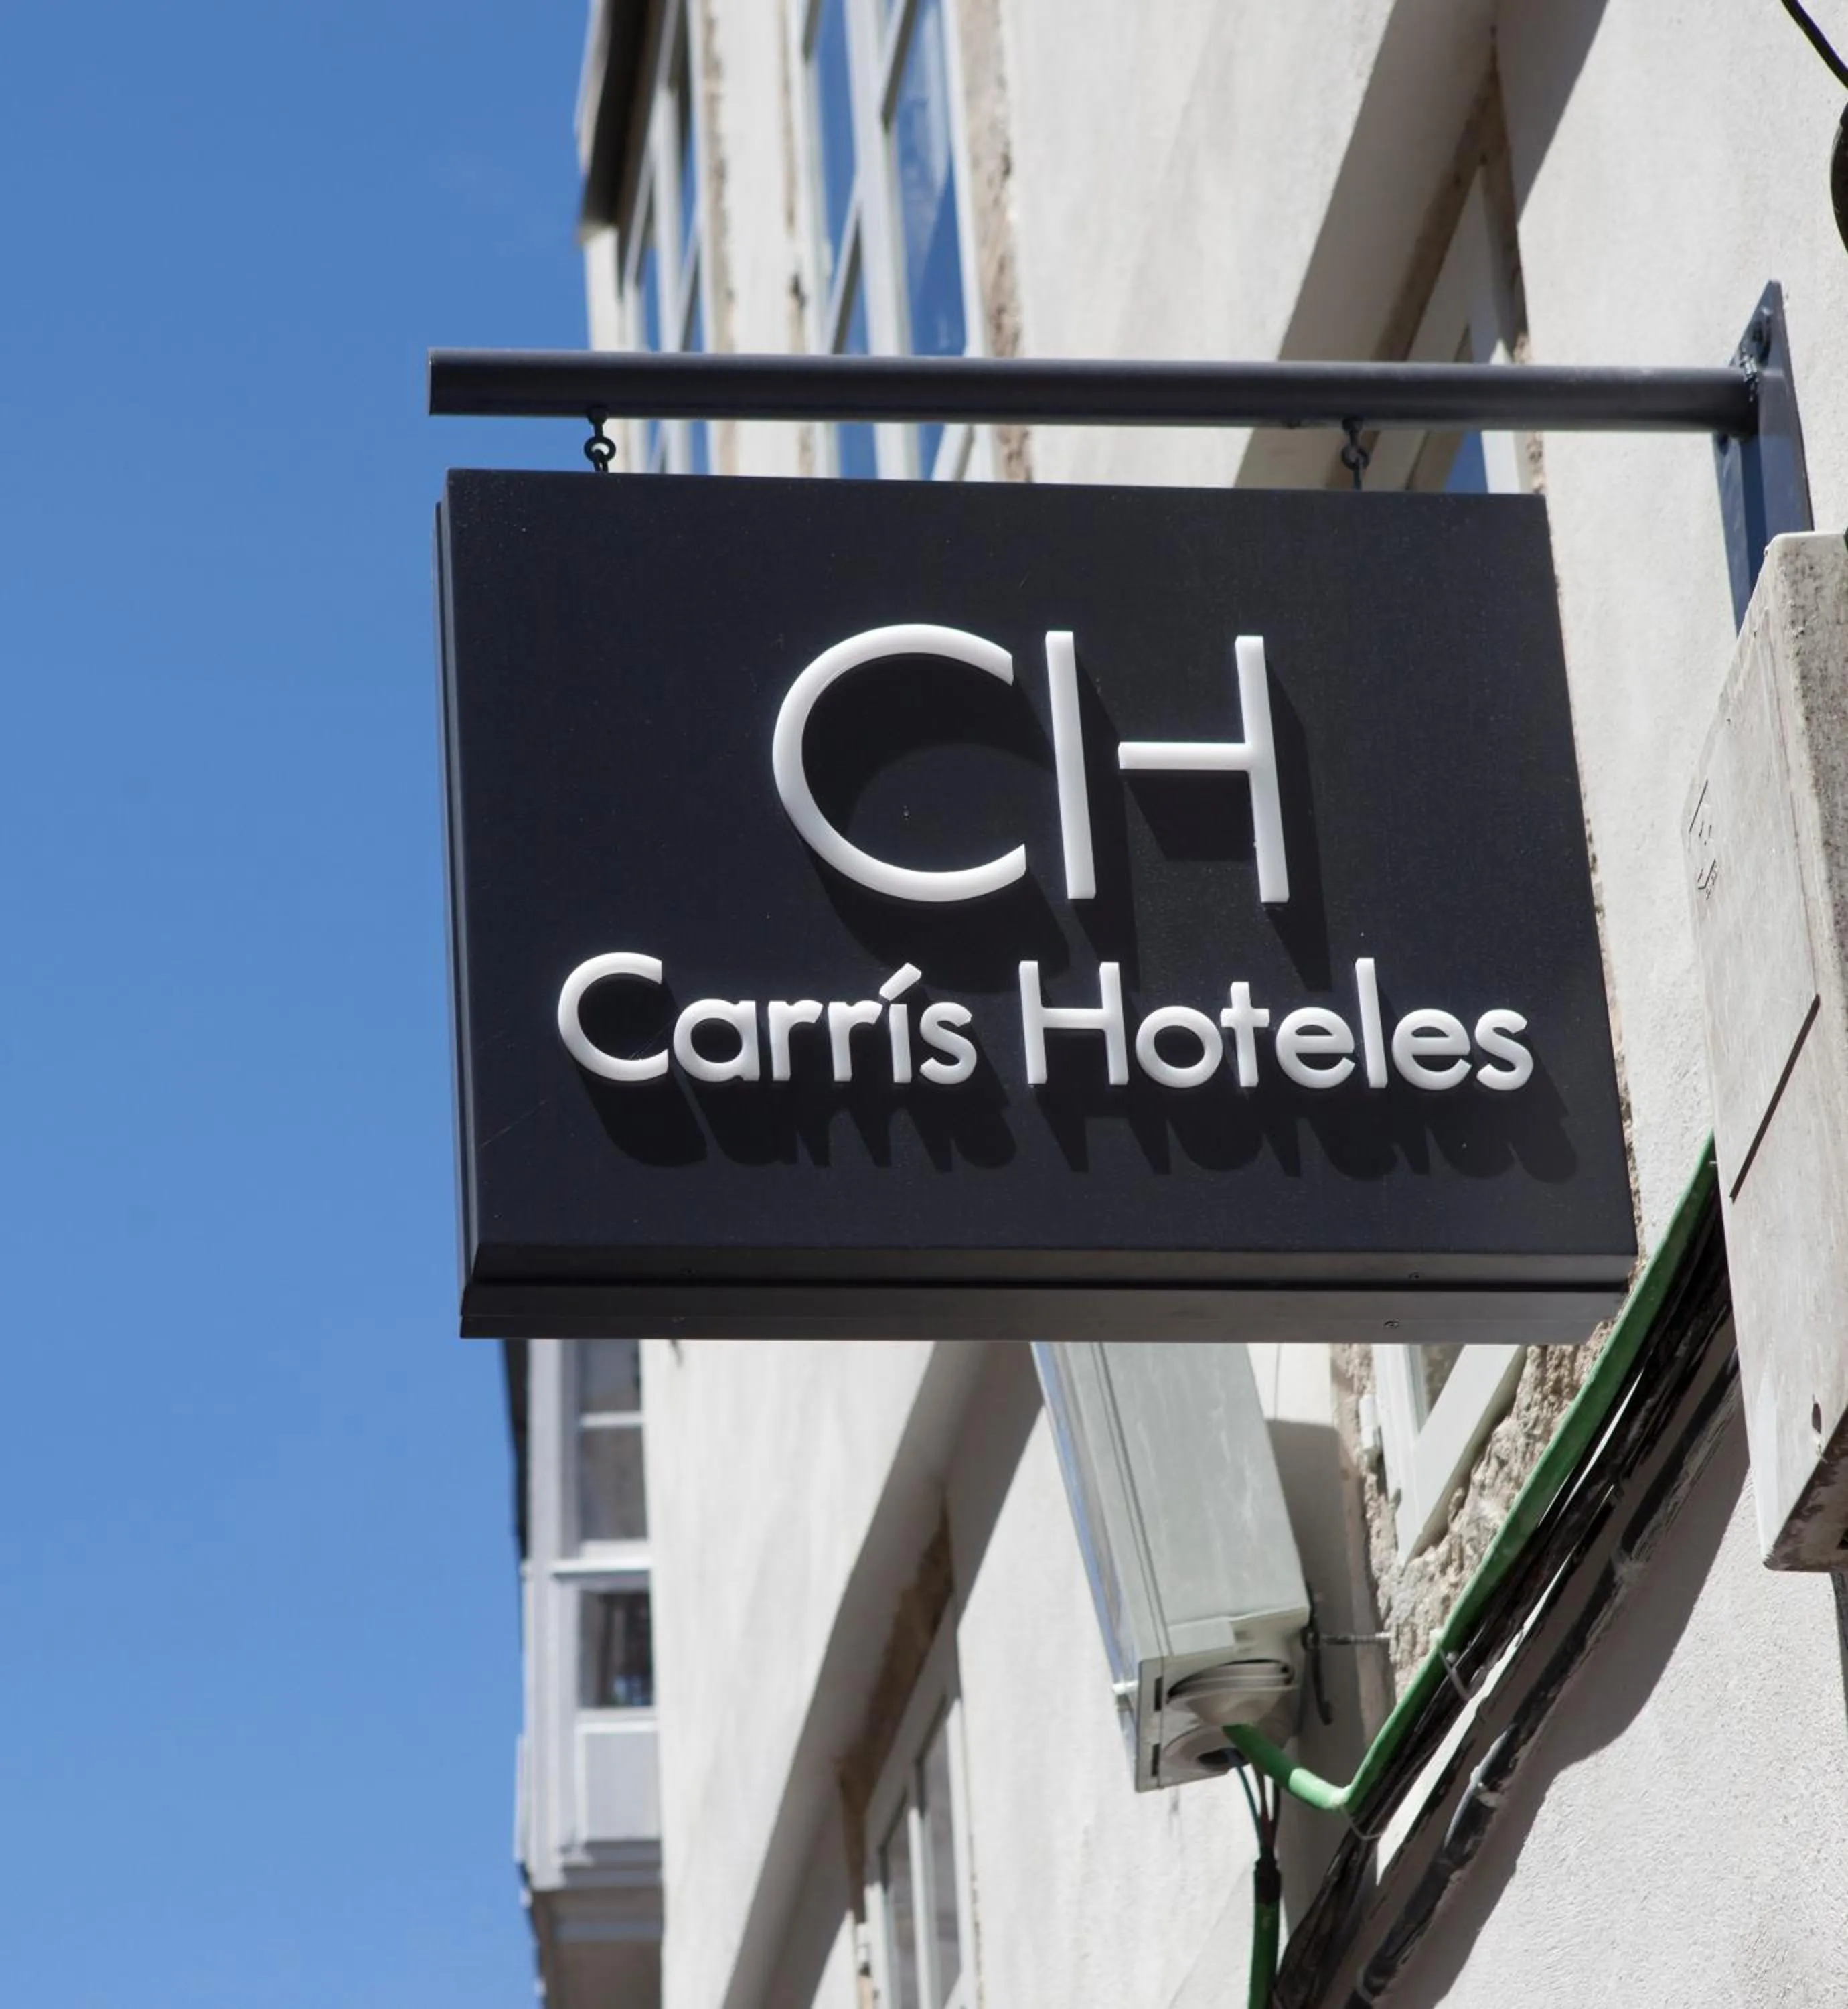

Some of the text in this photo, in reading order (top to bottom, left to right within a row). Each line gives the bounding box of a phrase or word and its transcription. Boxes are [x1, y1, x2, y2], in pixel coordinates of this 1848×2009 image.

[771, 623, 1290, 904] CH
[557, 951, 1535, 1090] Carrís Hoteles
